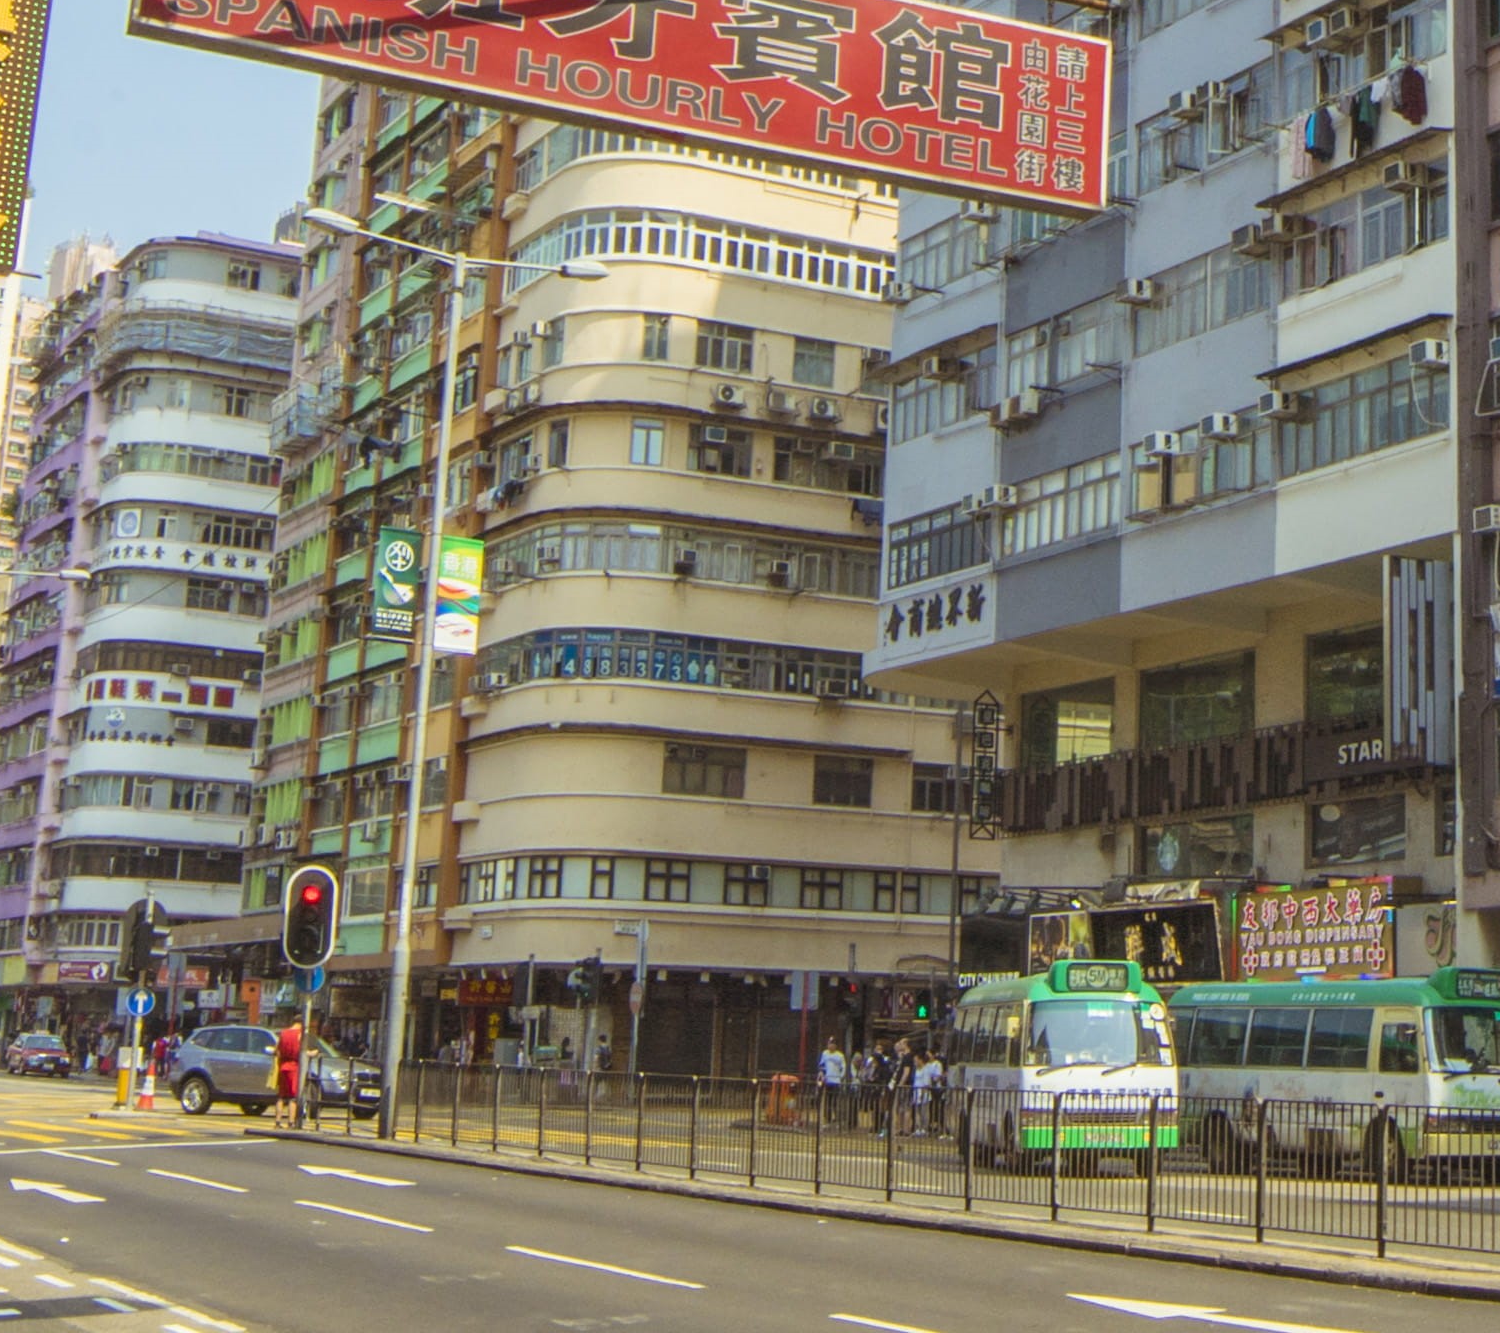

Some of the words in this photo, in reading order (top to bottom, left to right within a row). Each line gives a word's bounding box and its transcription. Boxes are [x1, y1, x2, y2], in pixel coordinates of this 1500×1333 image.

[515, 50, 785, 134] HOURLY
[813, 104, 1009, 180] HOTEL
[1015, 39, 1050, 185] 由花園街
[1054, 44, 1087, 193] 請上三樓
